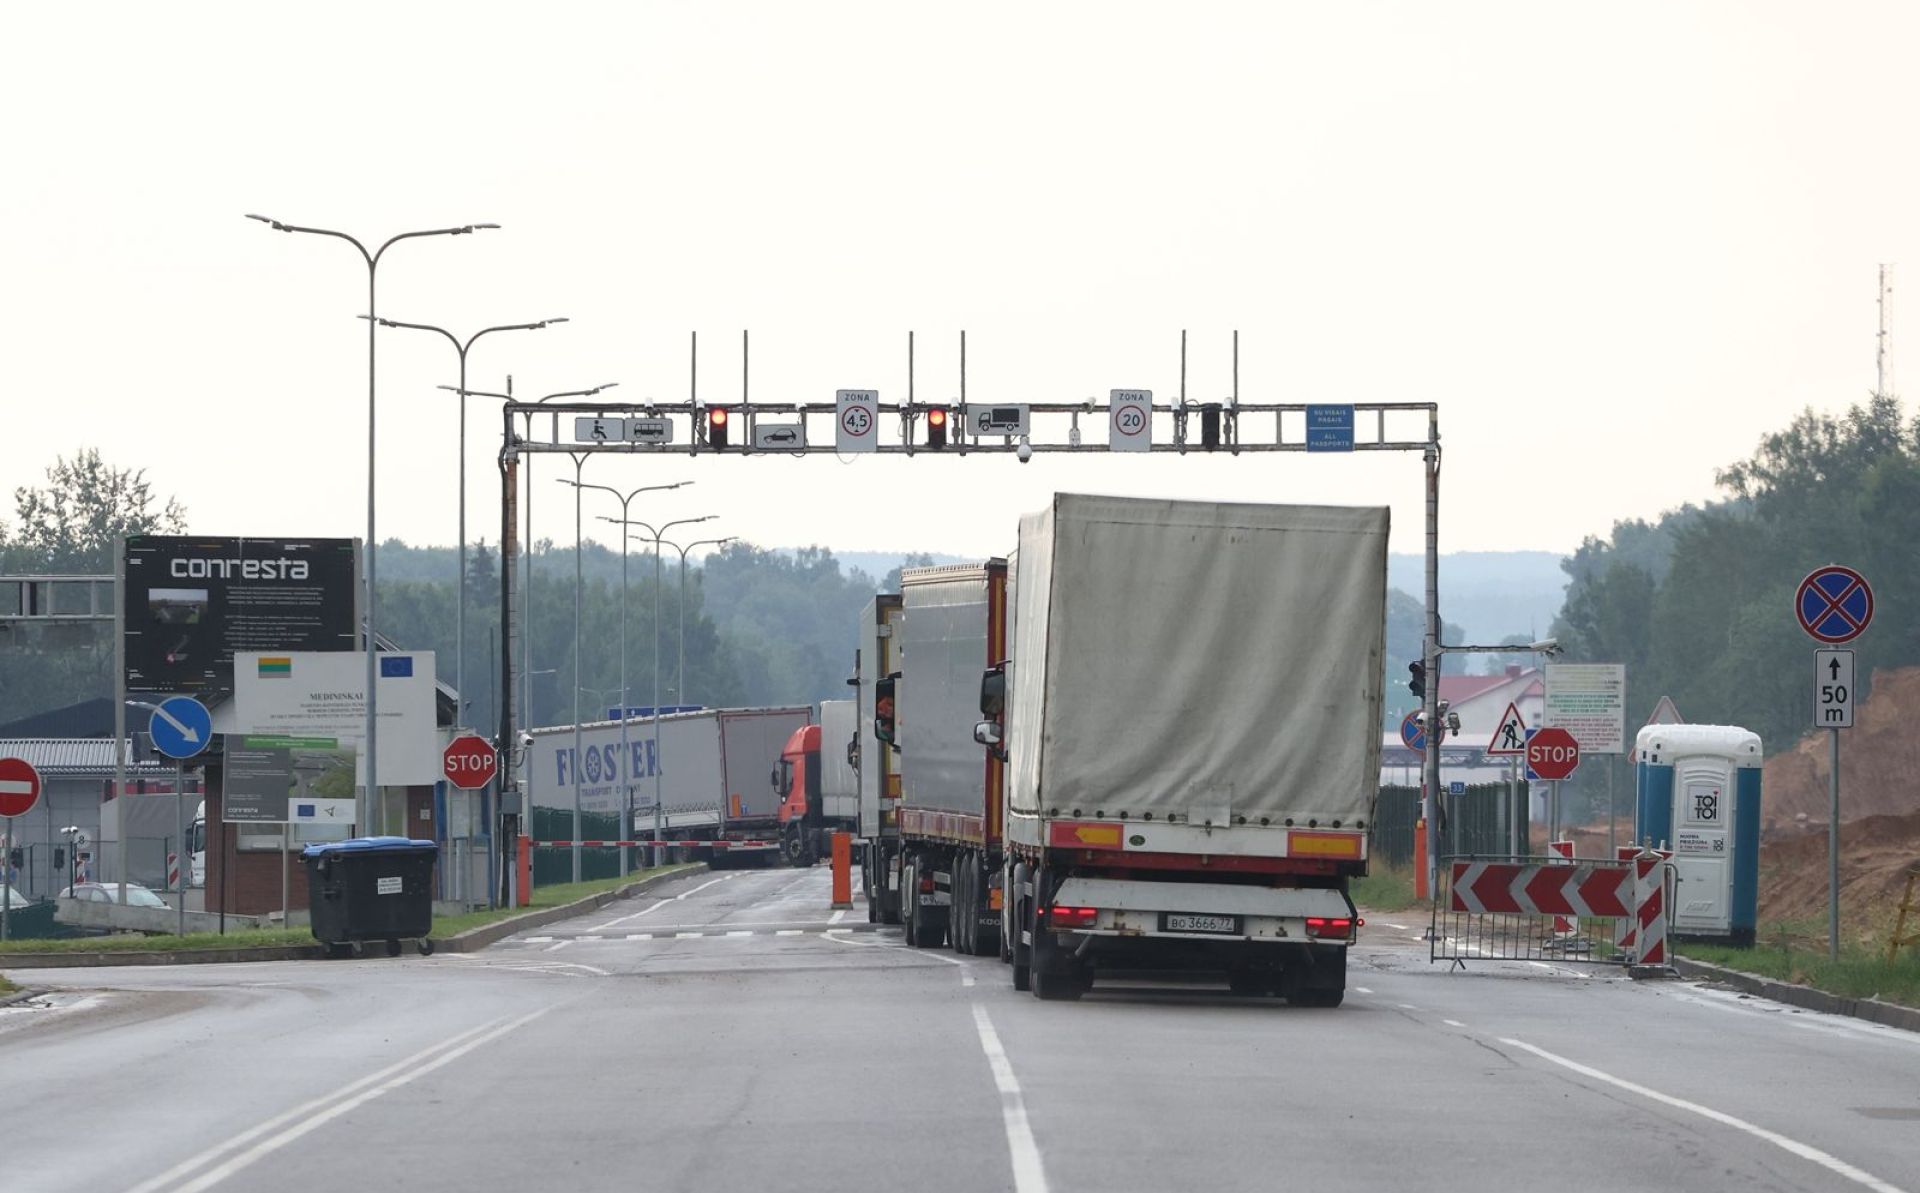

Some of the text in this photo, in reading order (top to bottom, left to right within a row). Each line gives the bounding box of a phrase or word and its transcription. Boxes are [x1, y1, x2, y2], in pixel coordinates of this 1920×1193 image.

[844, 393, 870, 401] ZONA
[1119, 393, 1144, 401] ZONA
[846, 414, 867, 428] 4,5
[1122, 413, 1140, 427] 20
[170, 557, 309, 580] conresta
[1822, 685, 1848, 704] 50
[1825, 708, 1843, 721] m
[1530, 745, 1577, 763] STOP
[446, 754, 493, 771] STOP
[1694, 807, 1717, 819] TOI
[1188, 917, 1217, 929] 3666
